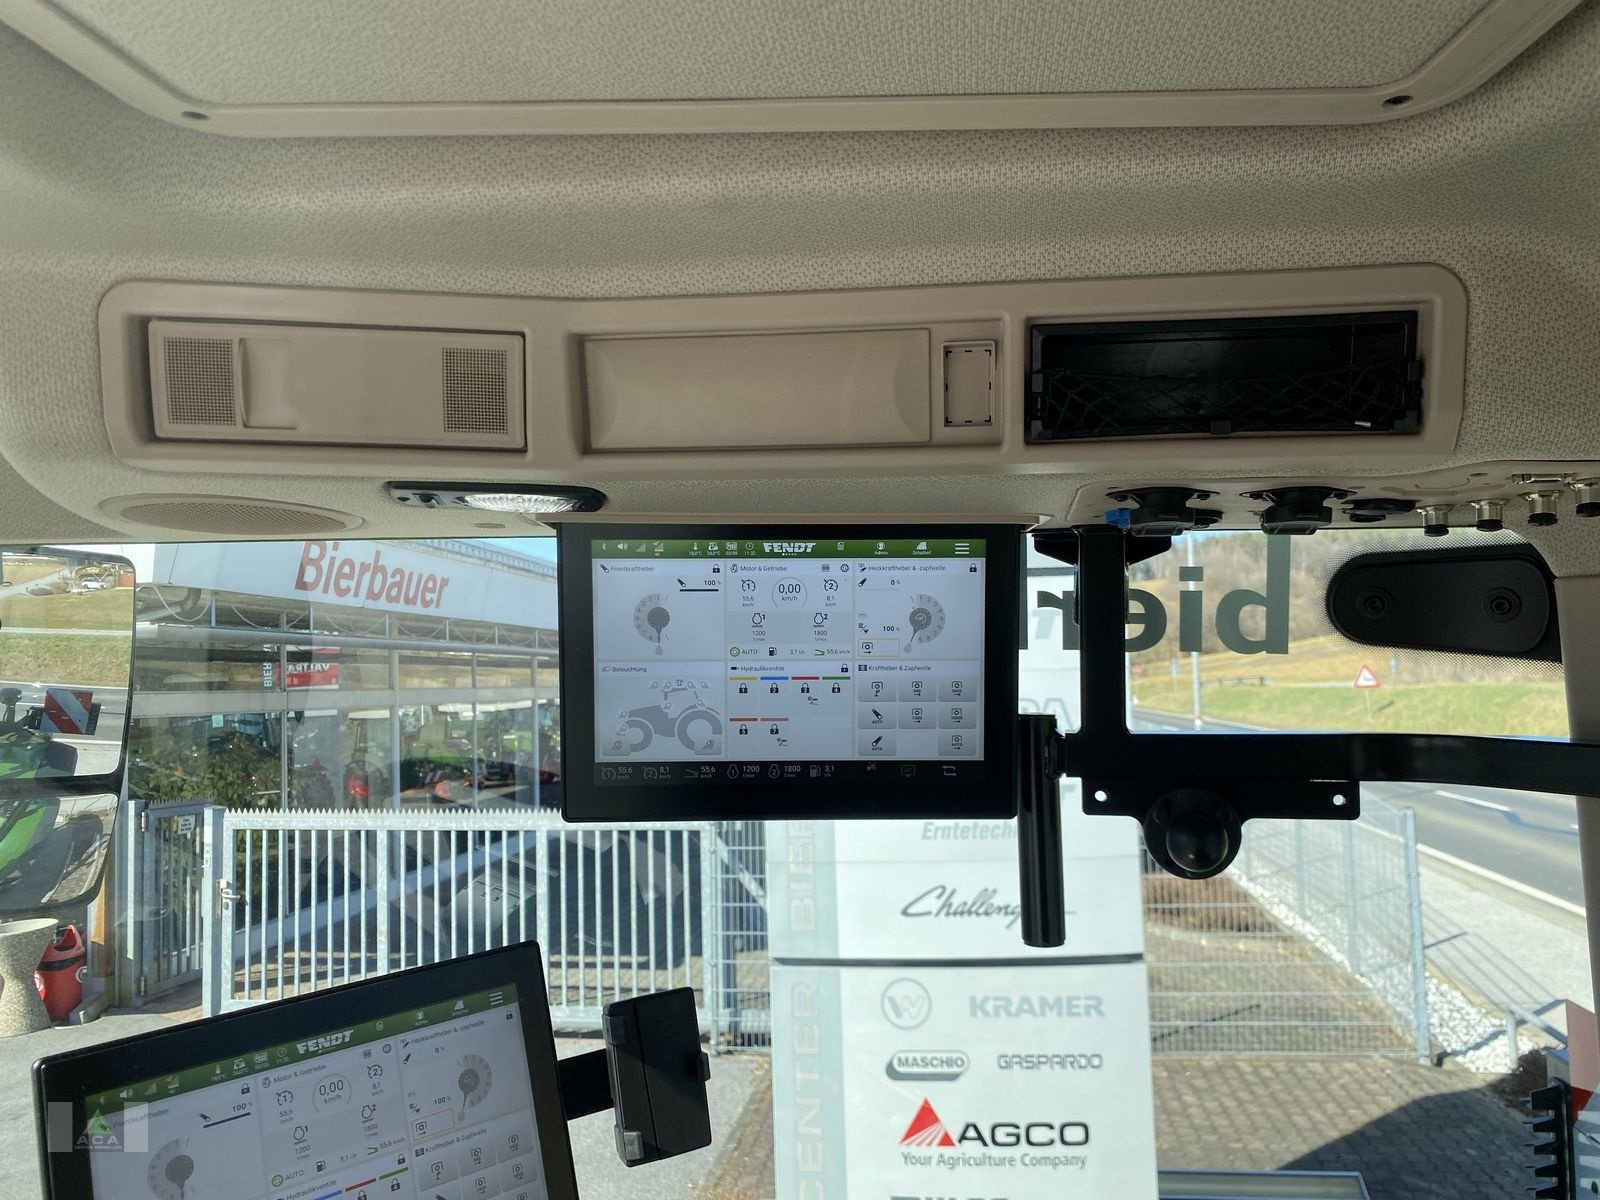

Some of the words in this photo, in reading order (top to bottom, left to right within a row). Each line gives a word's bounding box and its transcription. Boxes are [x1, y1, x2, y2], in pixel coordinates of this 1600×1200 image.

[762, 542, 816, 553] FENDT
[295, 541, 449, 609] Bierbauer
[778, 583, 801, 595] 0,00
[618, 766, 632, 774] 55,6
[659, 766, 670, 774] 8,1
[742, 765, 760, 773] 1200
[824, 765, 835, 773] 3,1
[900, 885, 1077, 930] Challeng
[968, 995, 1106, 1018] KRAMER
[296, 1029, 354, 1055] FENDT
[896, 1055, 965, 1068] MASCHIO
[997, 1053, 1103, 1070] GASPARDO
[273, 1073, 293, 1084] Motor
[318, 1079, 344, 1096] 0,00
[323, 1093, 342, 1104] km/h
[434, 1096, 446, 1105] 100
[231, 1102, 247, 1113] 100
[957, 1121, 1090, 1147] AGCO
[901, 1152, 932, 1166] Your
[936, 1152, 1016, 1169] Agriculture
[1020, 1152, 1087, 1169] Company
[285, 1169, 304, 1181] AUTO
